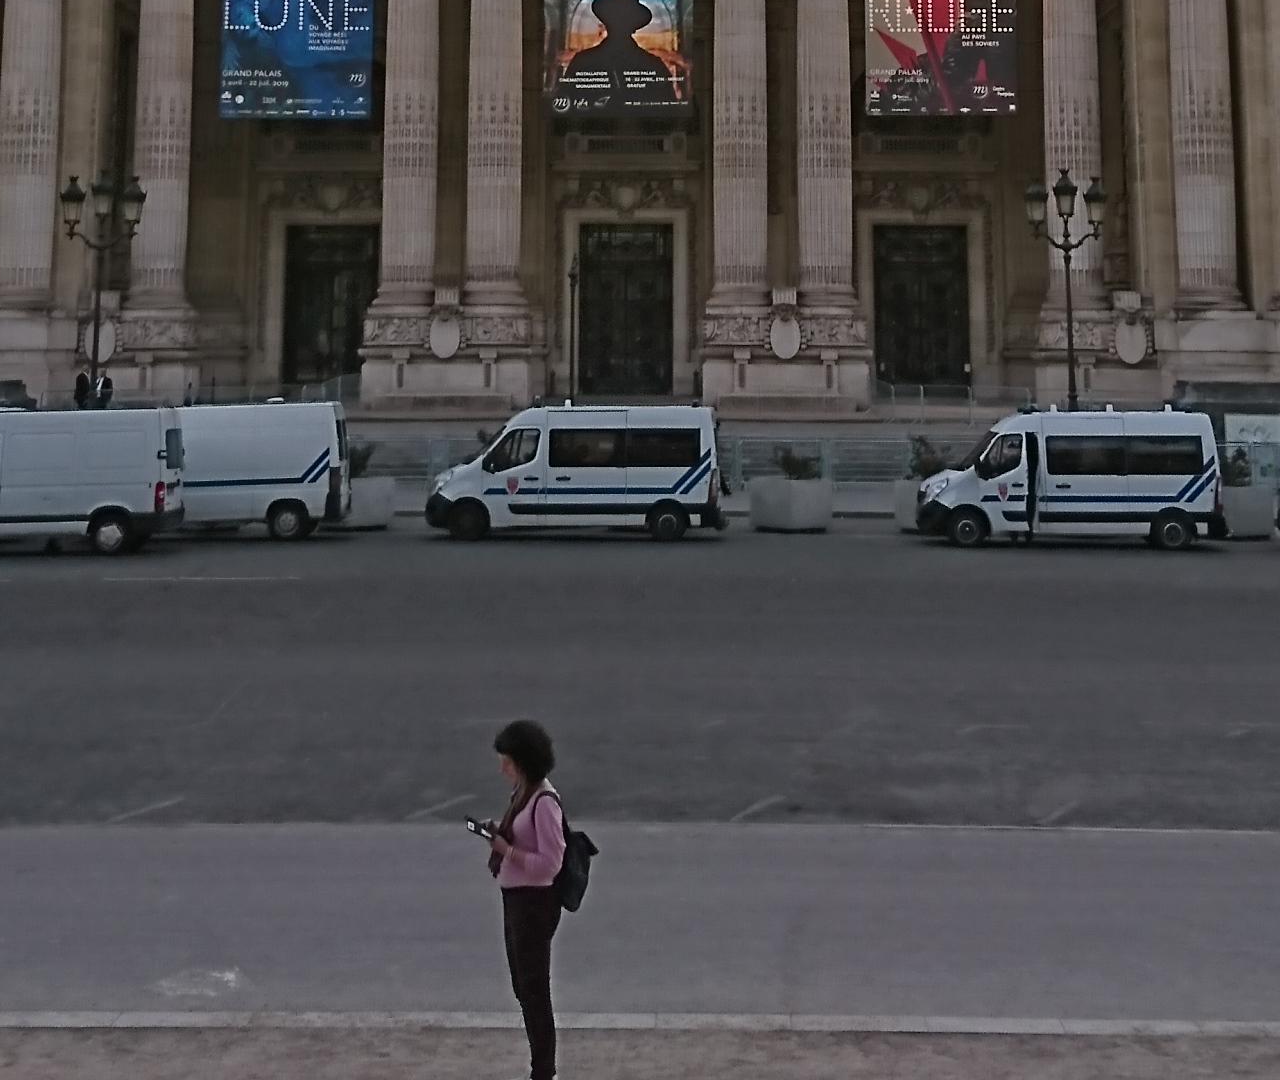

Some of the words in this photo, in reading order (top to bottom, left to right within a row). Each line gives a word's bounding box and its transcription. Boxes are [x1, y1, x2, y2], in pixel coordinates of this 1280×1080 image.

[222, 69, 252, 77] GRAND
[254, 69, 282, 77] PALAIS
[898, 68, 923, 76] PALAIS
[272, 80, 289, 88] 2019
